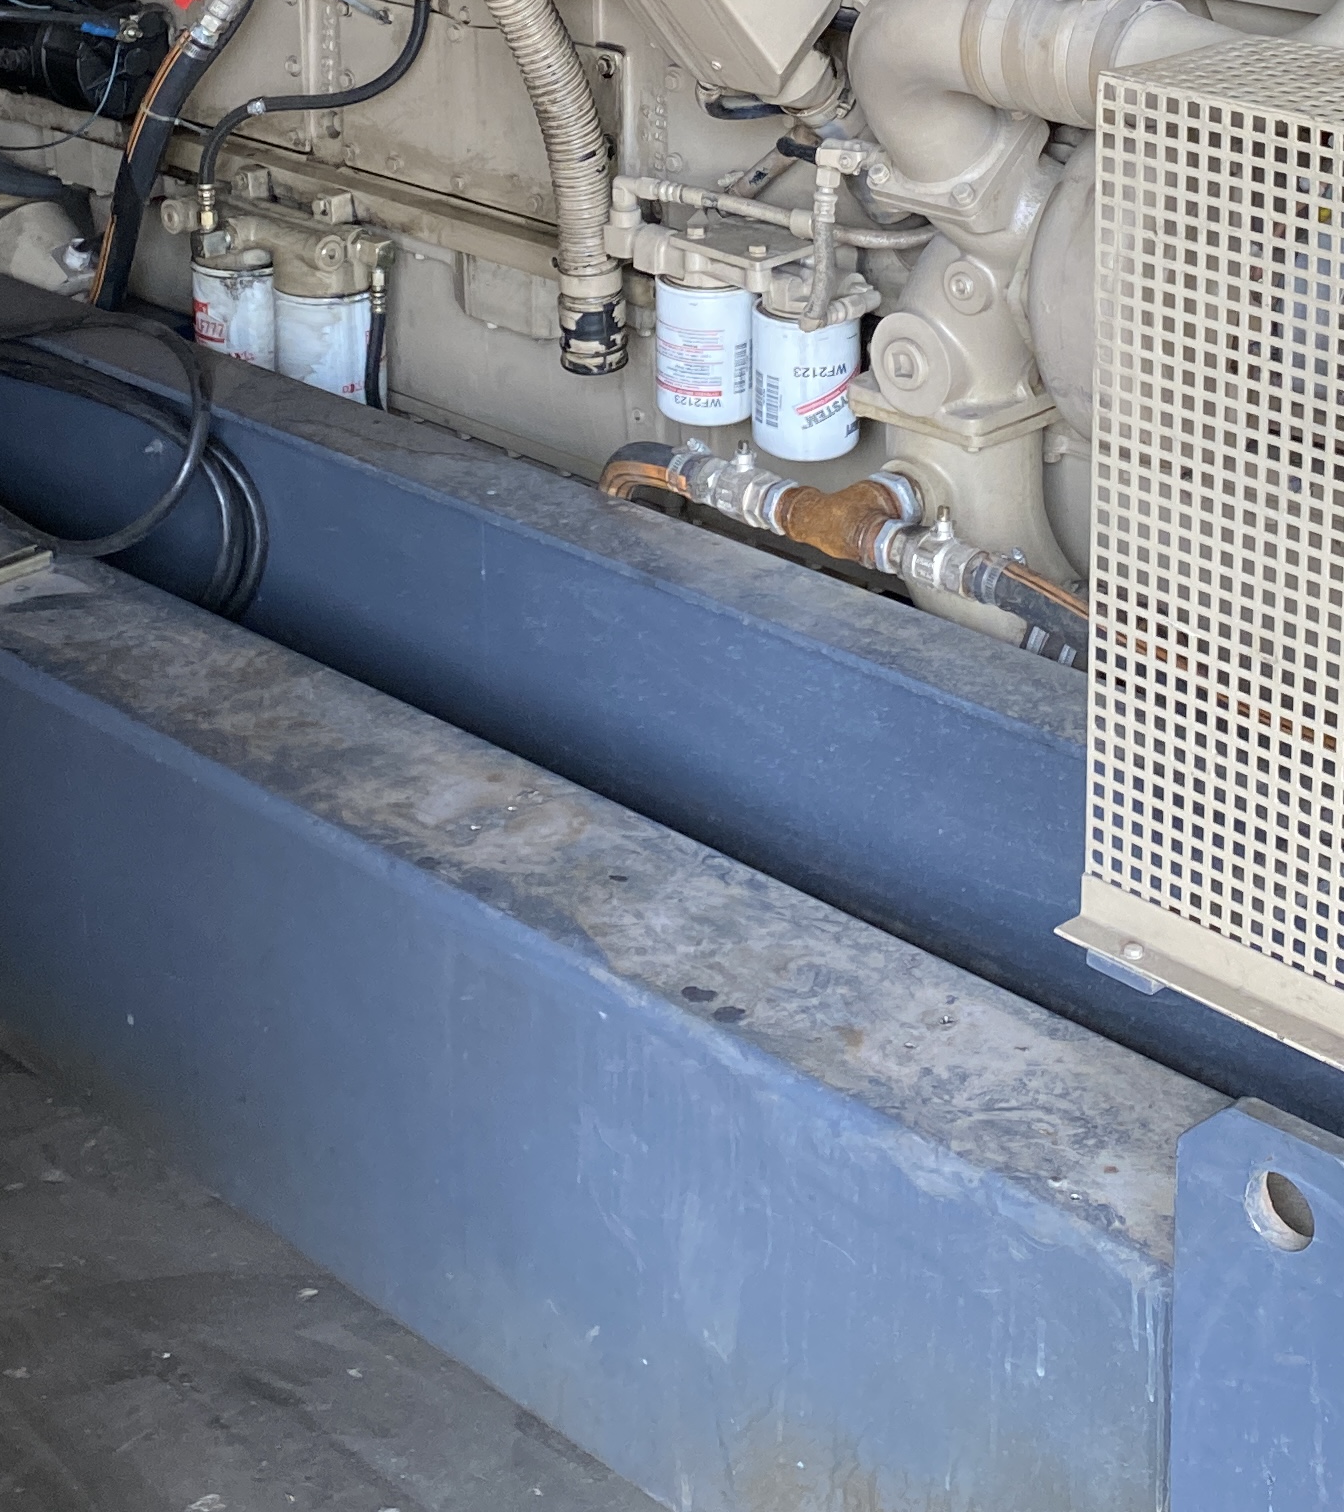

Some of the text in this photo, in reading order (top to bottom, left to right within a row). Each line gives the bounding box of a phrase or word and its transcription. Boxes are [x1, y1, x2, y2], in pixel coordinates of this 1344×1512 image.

[793, 362, 847, 379] WF2123
[673, 394, 724, 409] WF2123
[805, 393, 849, 428] YSTEM
